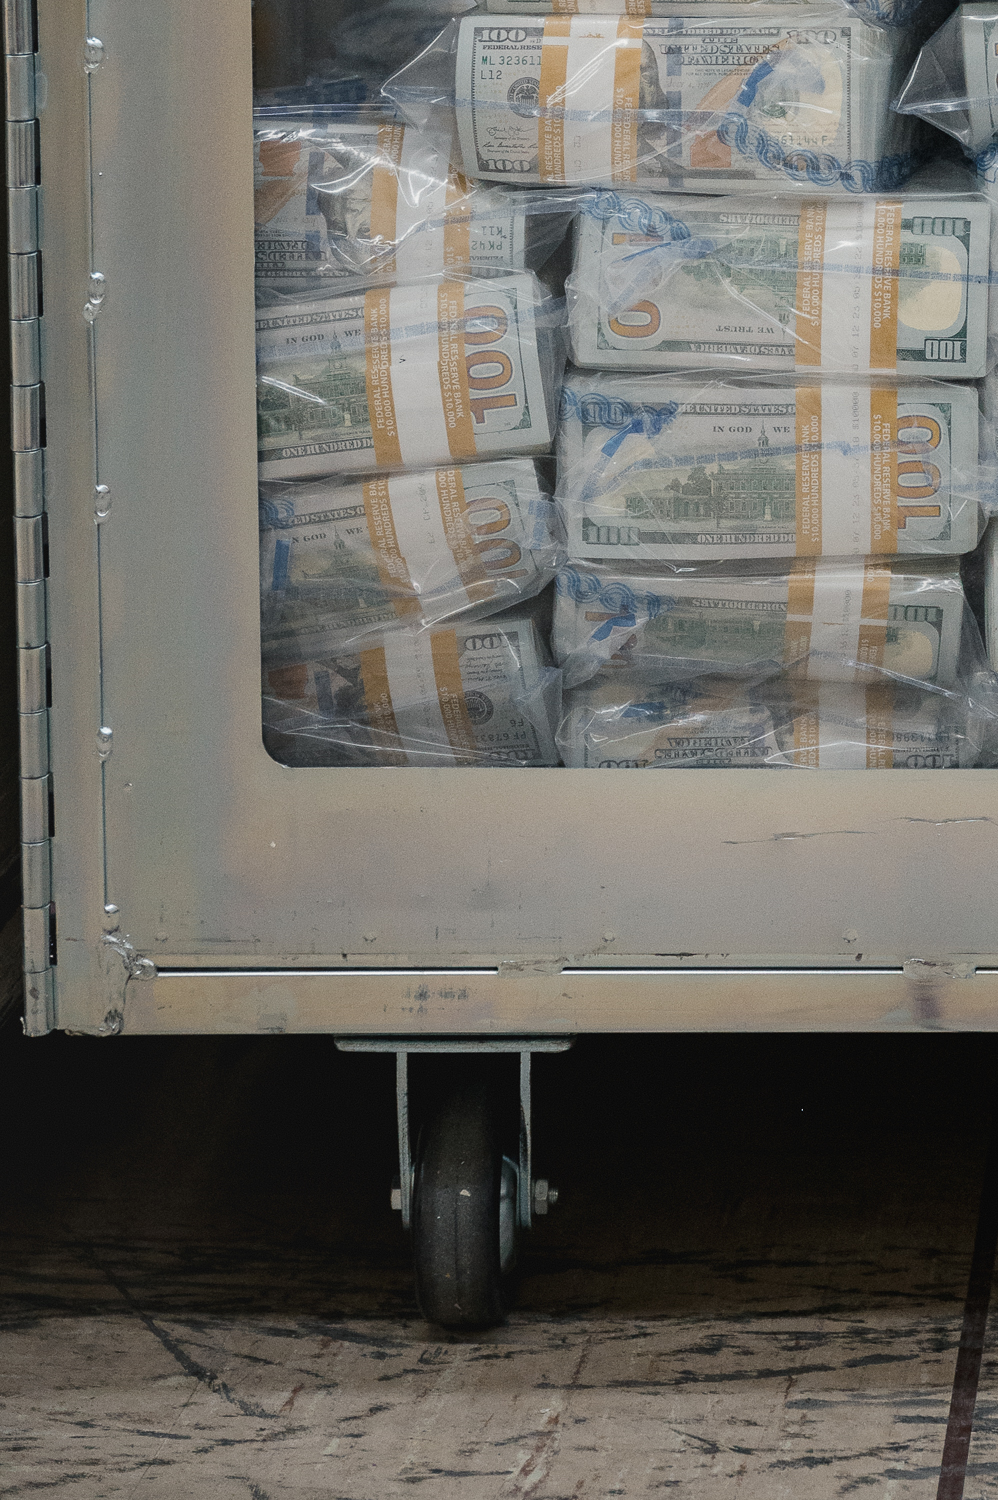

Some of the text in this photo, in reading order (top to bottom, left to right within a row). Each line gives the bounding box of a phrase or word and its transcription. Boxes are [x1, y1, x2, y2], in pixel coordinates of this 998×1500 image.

[477, 29, 527, 43] 100
[480, 70, 503, 80] L12
[486, 159, 531, 172] 100
[810, 291, 820, 327] $10,000
[873, 289, 883, 329] $10,000
[882, 289, 892, 319] BANK
[370, 308, 378, 333] BANK
[715, 325, 775, 334] WE TRUST
[286, 333, 325, 345] IN GOD
[343, 328, 362, 338] WE
[924, 338, 966, 361] 100
[464, 304, 518, 425] 100
[376, 383, 385, 430] FEDERAL
[454, 392, 465, 418] BANK
[694, 404, 788, 414] UNITED STATES
[384, 407, 396, 437] $10,000
[713, 425, 753, 433] IN GOD
[772, 425, 791, 433] WE
[281, 438, 362, 458] ONE HUNDRED
[897, 414, 942, 530] 100
[801, 453, 810, 535] FEDERAL RESERVE
[882, 466, 892, 505] RESERVE
[810, 454, 820, 542] $10,000 HUNDREDS
[302, 531, 328, 543] GOD
[345, 526, 363, 536] WE
[696, 534, 782, 543] ONE HUNDRED
